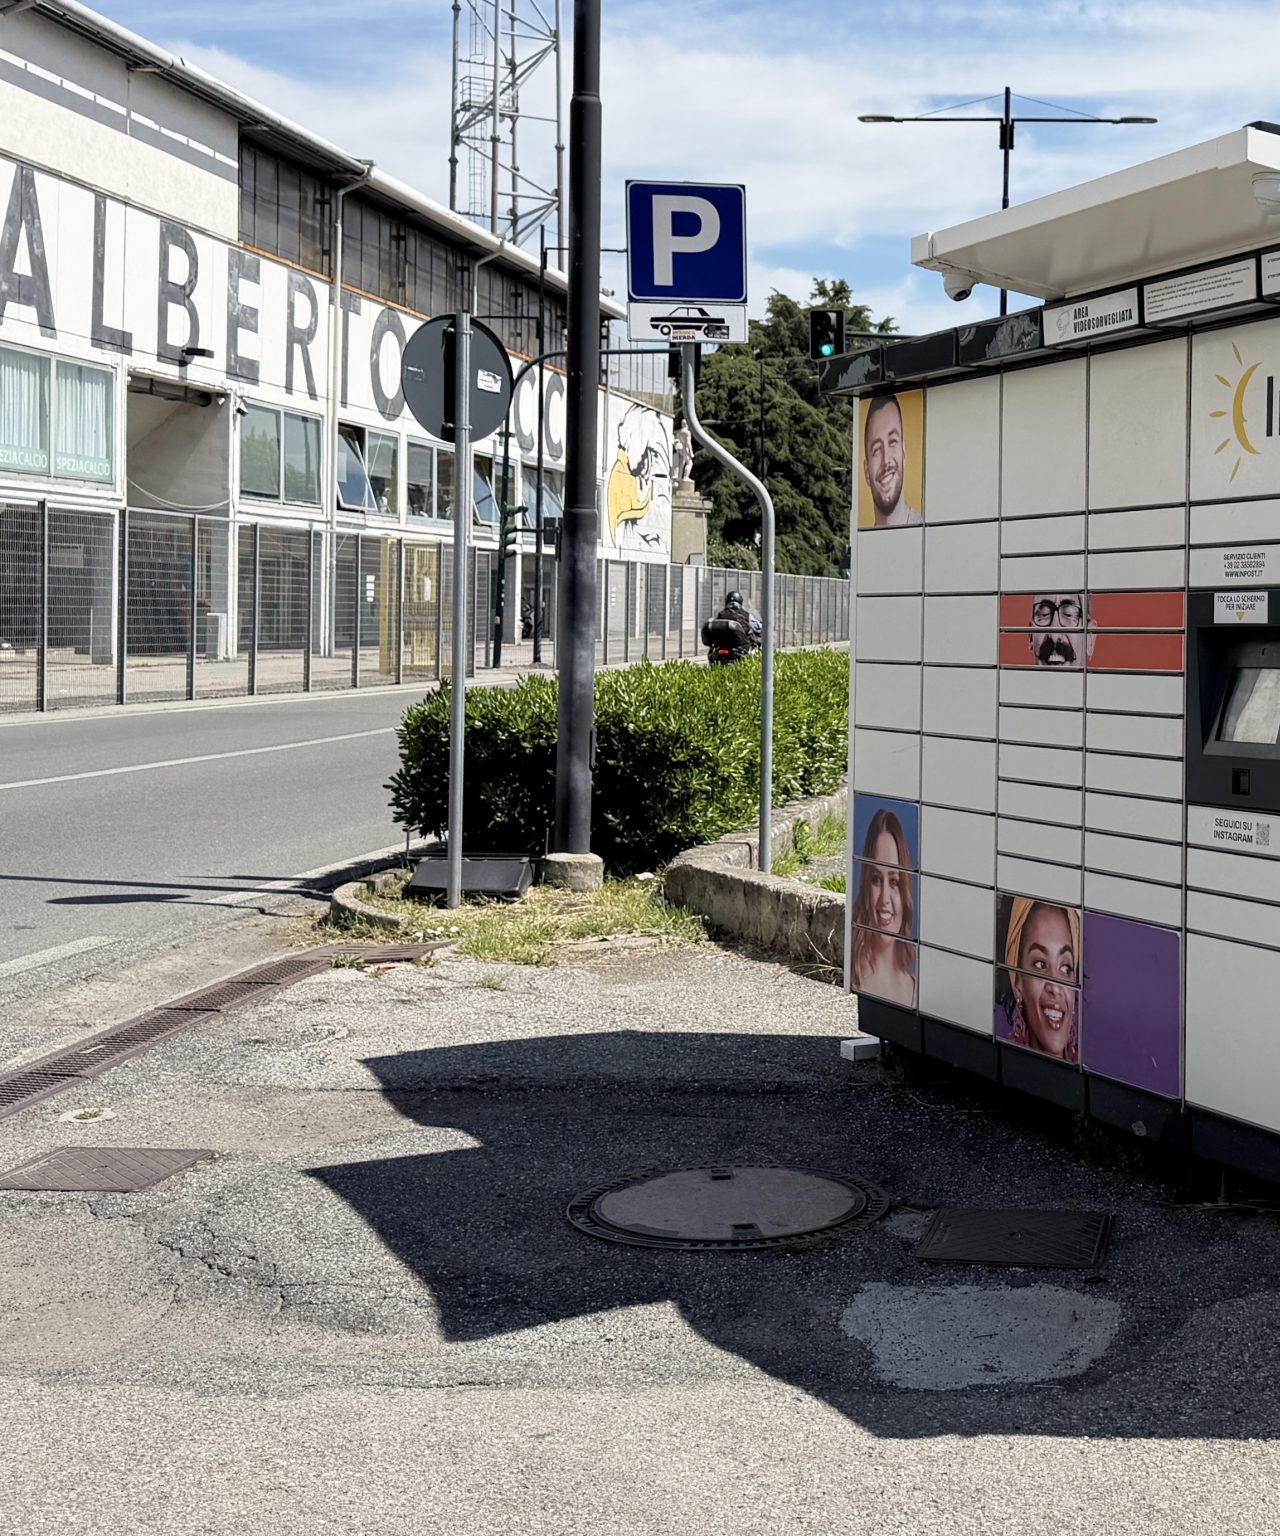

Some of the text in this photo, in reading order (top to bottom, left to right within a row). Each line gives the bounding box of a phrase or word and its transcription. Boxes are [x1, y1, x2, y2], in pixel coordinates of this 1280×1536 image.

[652, 194, 721, 286] P
[0, 162, 407, 421] ALBERTO
[1073, 305, 1089, 320] AREA
[1073, 307, 1133, 333] VIDEOSORVEGLIATA
[1223, 552, 1266, 561] SERVIZIO CLIENTI
[1241, 595, 1265, 603] SCHERMO
[1225, 603, 1235, 611] PER
[1215, 817, 1252, 831] SEGUICI SU
[1213, 829, 1253, 844] INSTAGRAM
